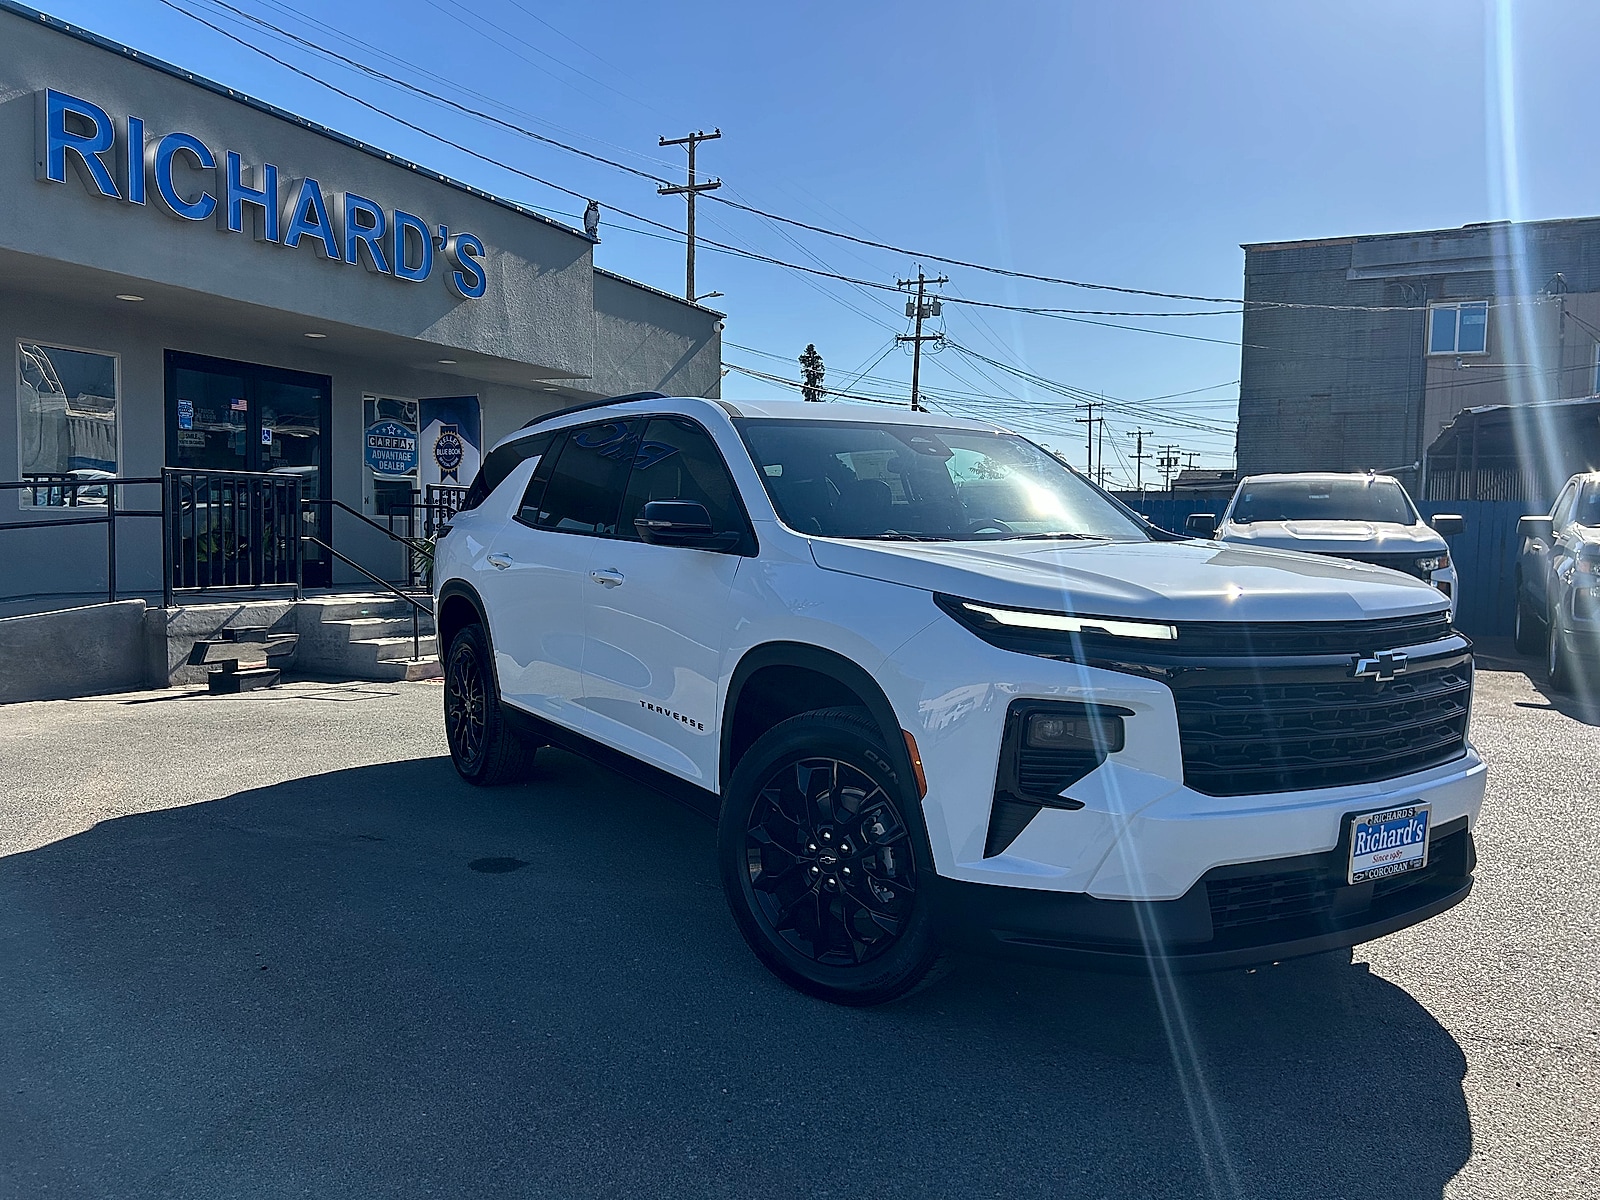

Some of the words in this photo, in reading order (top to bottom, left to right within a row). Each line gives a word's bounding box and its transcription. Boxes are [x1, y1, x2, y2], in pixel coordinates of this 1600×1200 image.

[40, 87, 487, 300] RICHARD'S
[369, 436, 415, 450] CARFAX
[439, 435, 460, 447] KELLEY
[372, 449, 414, 462] ADVANTAGE
[436, 448, 448, 456] BLUE
[379, 460, 405, 471] DEALER
[639, 700, 704, 731] TRAVERSE
[1354, 819, 1424, 855] Richard's
[1372, 853, 1390, 863] Since
[1368, 861, 1409, 879] CORCORAN
